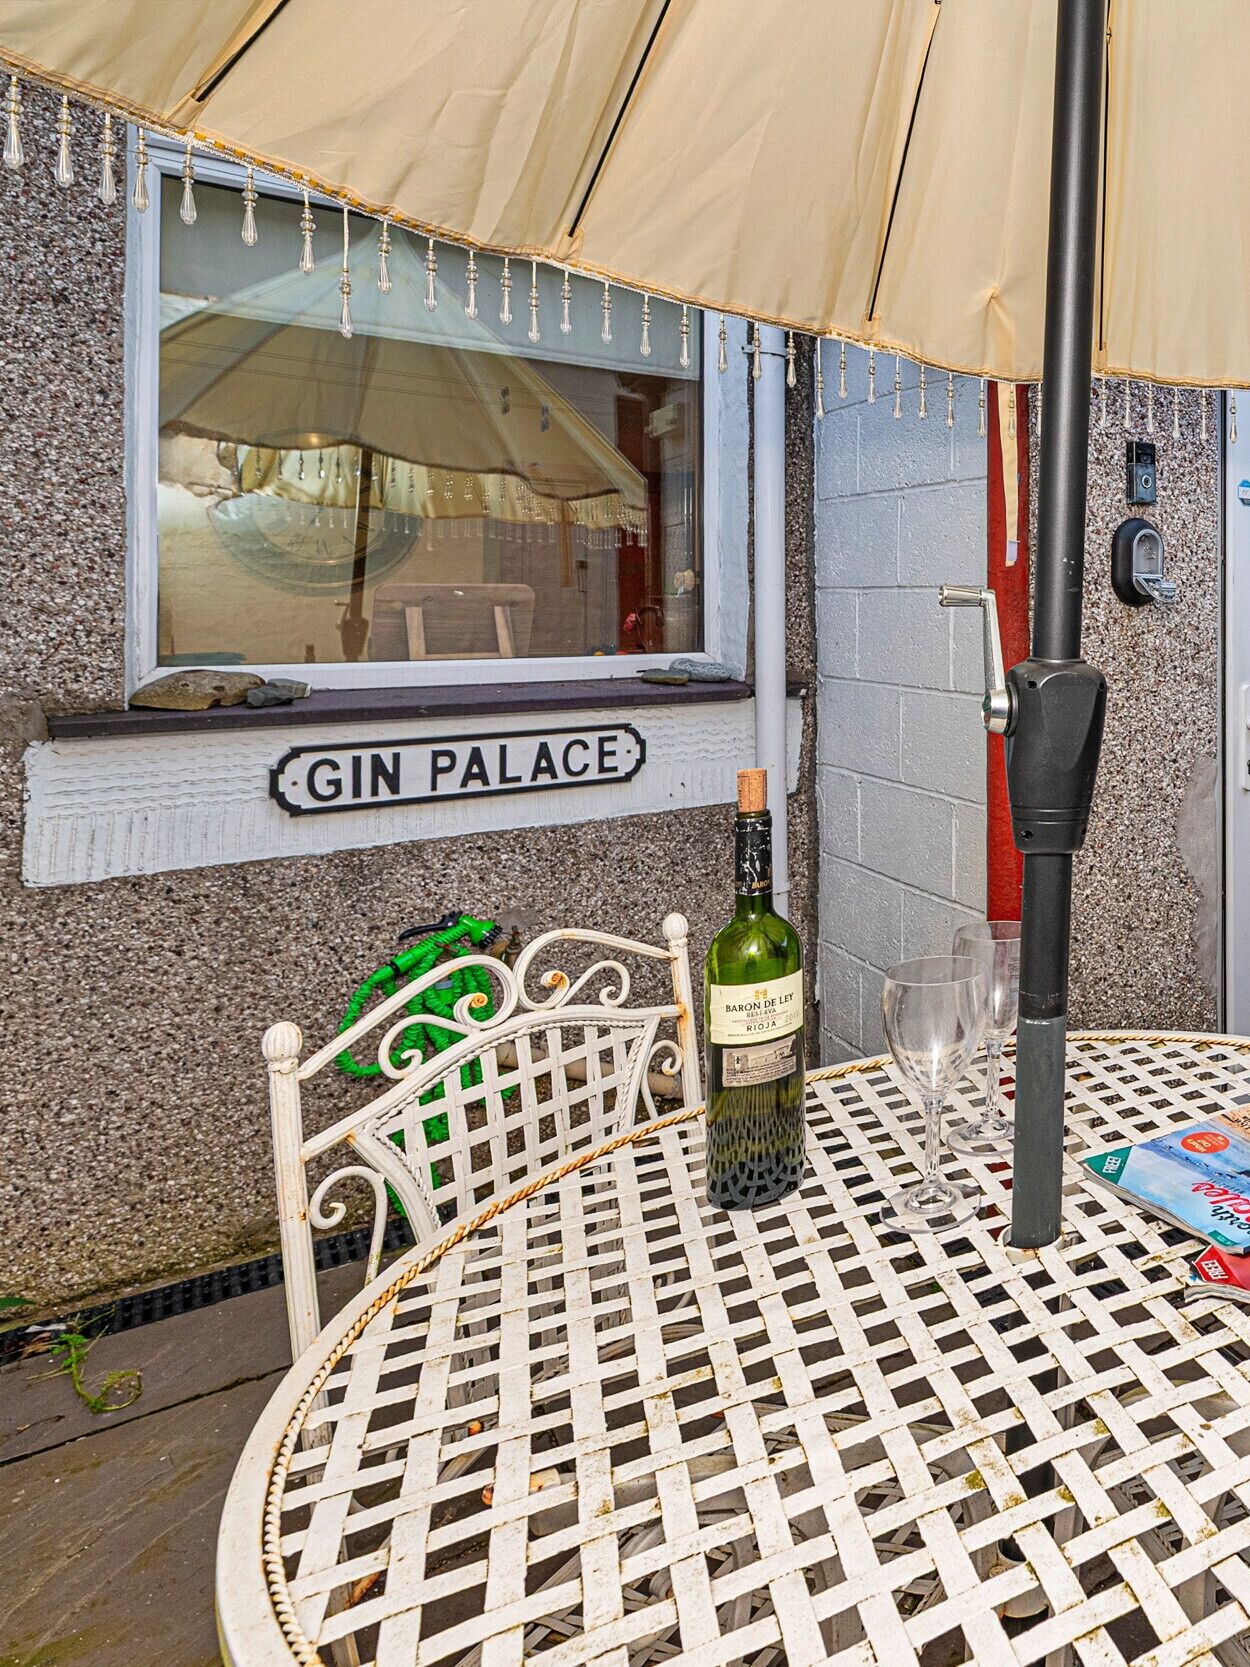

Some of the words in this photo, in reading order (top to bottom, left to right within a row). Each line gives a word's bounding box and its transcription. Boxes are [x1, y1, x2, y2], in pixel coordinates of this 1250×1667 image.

[306, 752, 401, 802] GIN
[430, 735, 619, 792] PALACE
[725, 1002, 760, 1012] BARON
[764, 998, 777, 1008] DE
[780, 992, 794, 1004] LEY
[746, 1008, 777, 1017] RESERVA
[746, 1021, 777, 1031] RIOJA
[1201, 1260, 1229, 1280] FREE
